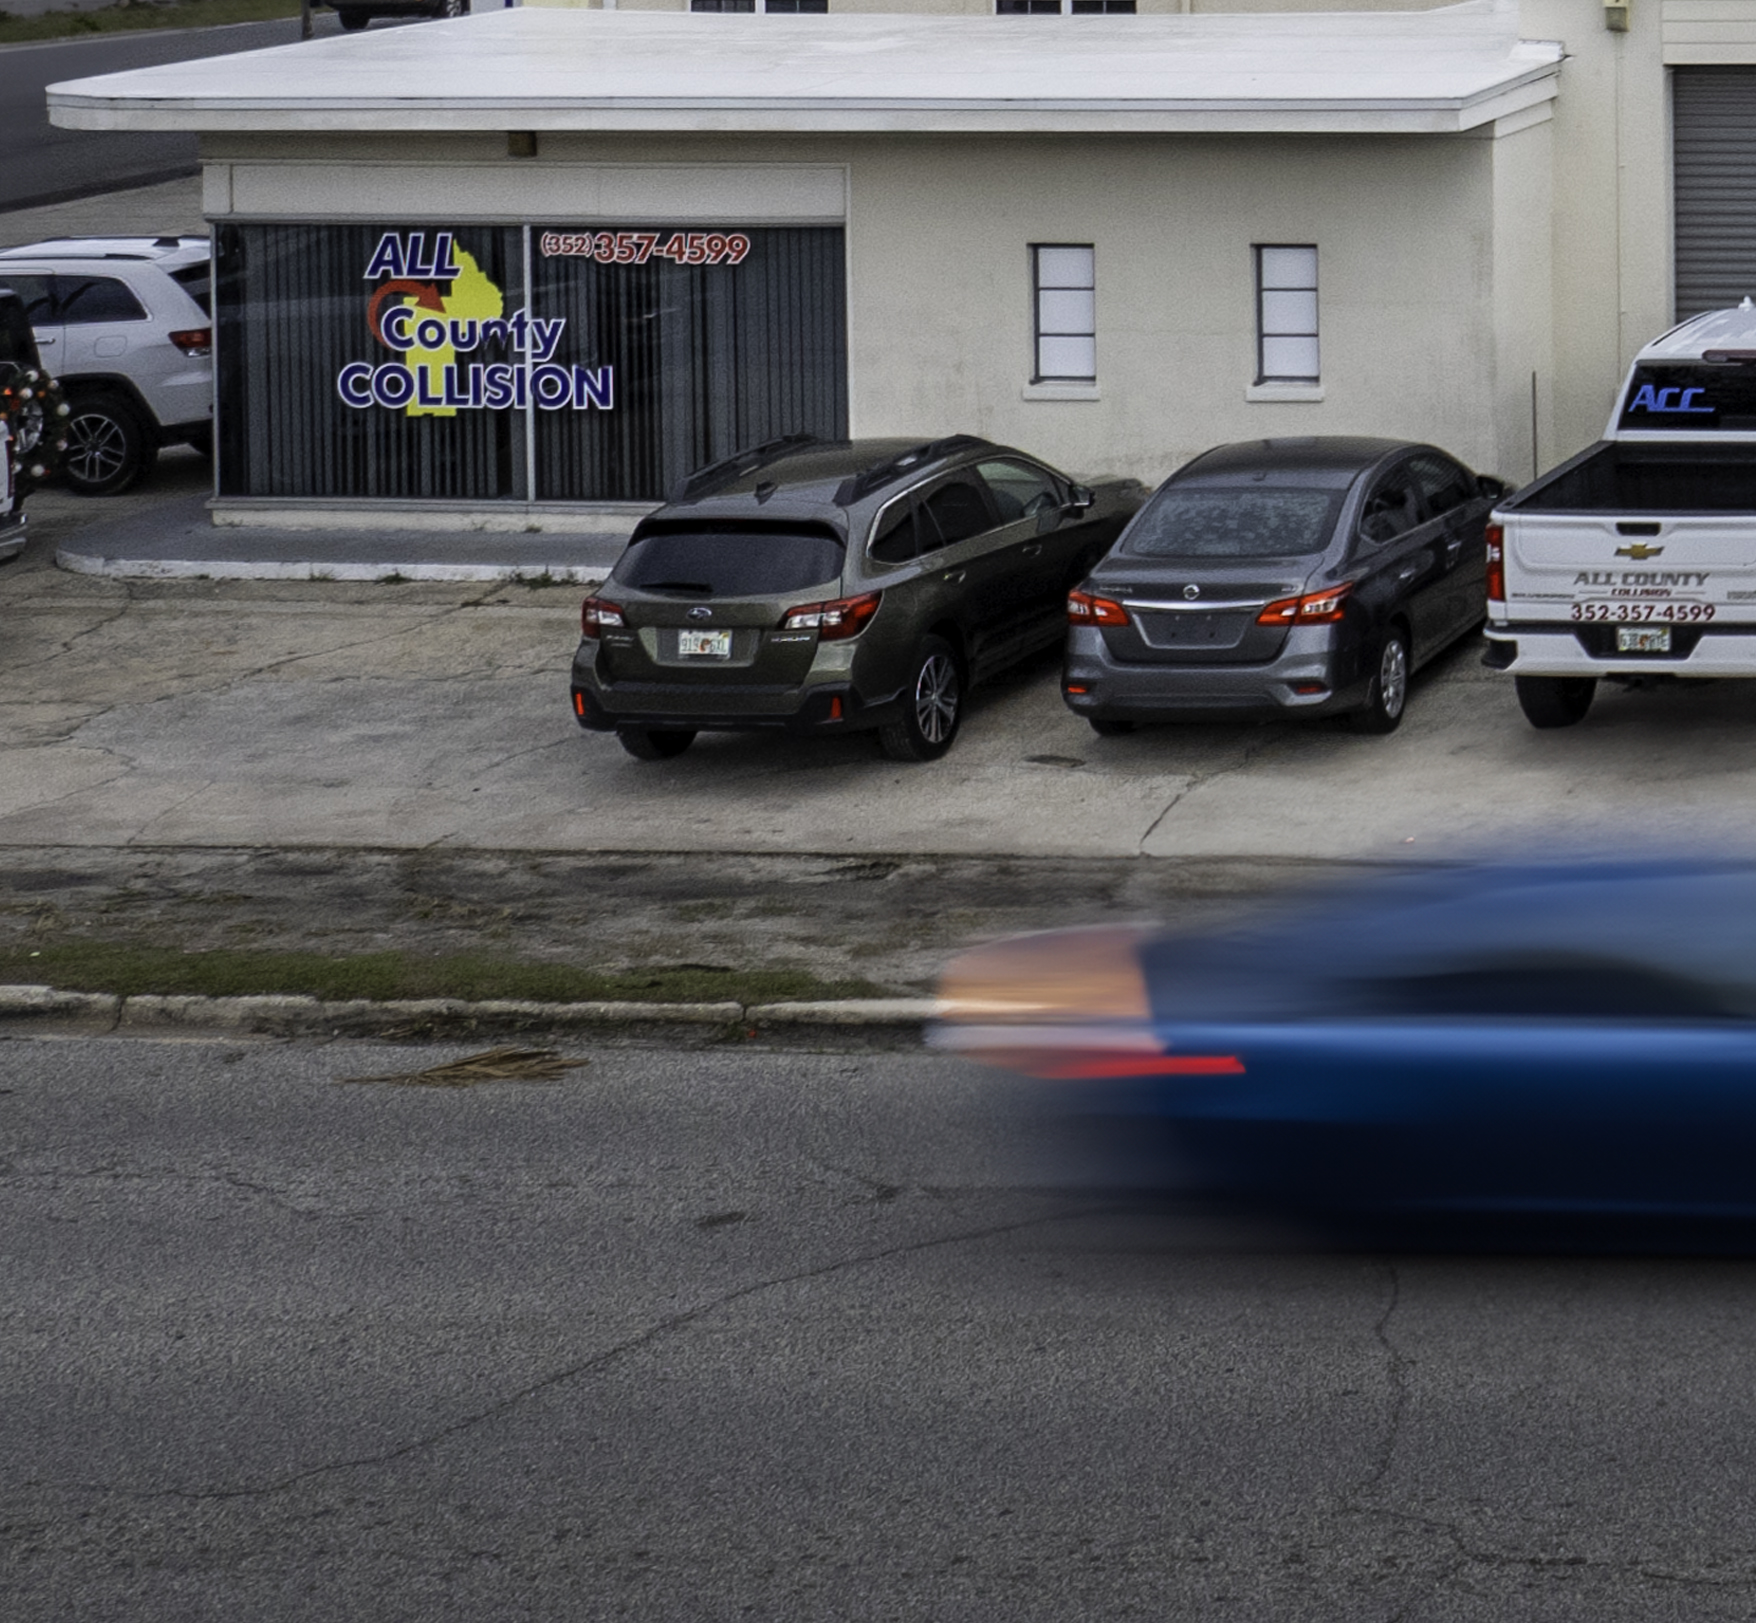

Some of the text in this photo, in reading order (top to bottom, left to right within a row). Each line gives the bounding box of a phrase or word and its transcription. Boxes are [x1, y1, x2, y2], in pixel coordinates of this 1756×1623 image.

[363, 232, 464, 279] ALL
[380, 305, 567, 363] County
[337, 362, 614, 411] COLLISION
[1628, 384, 1716, 412] ACC
[1574, 572, 1711, 587] ALL COUNTY
[1571, 603, 1717, 622] 352-357-4599
